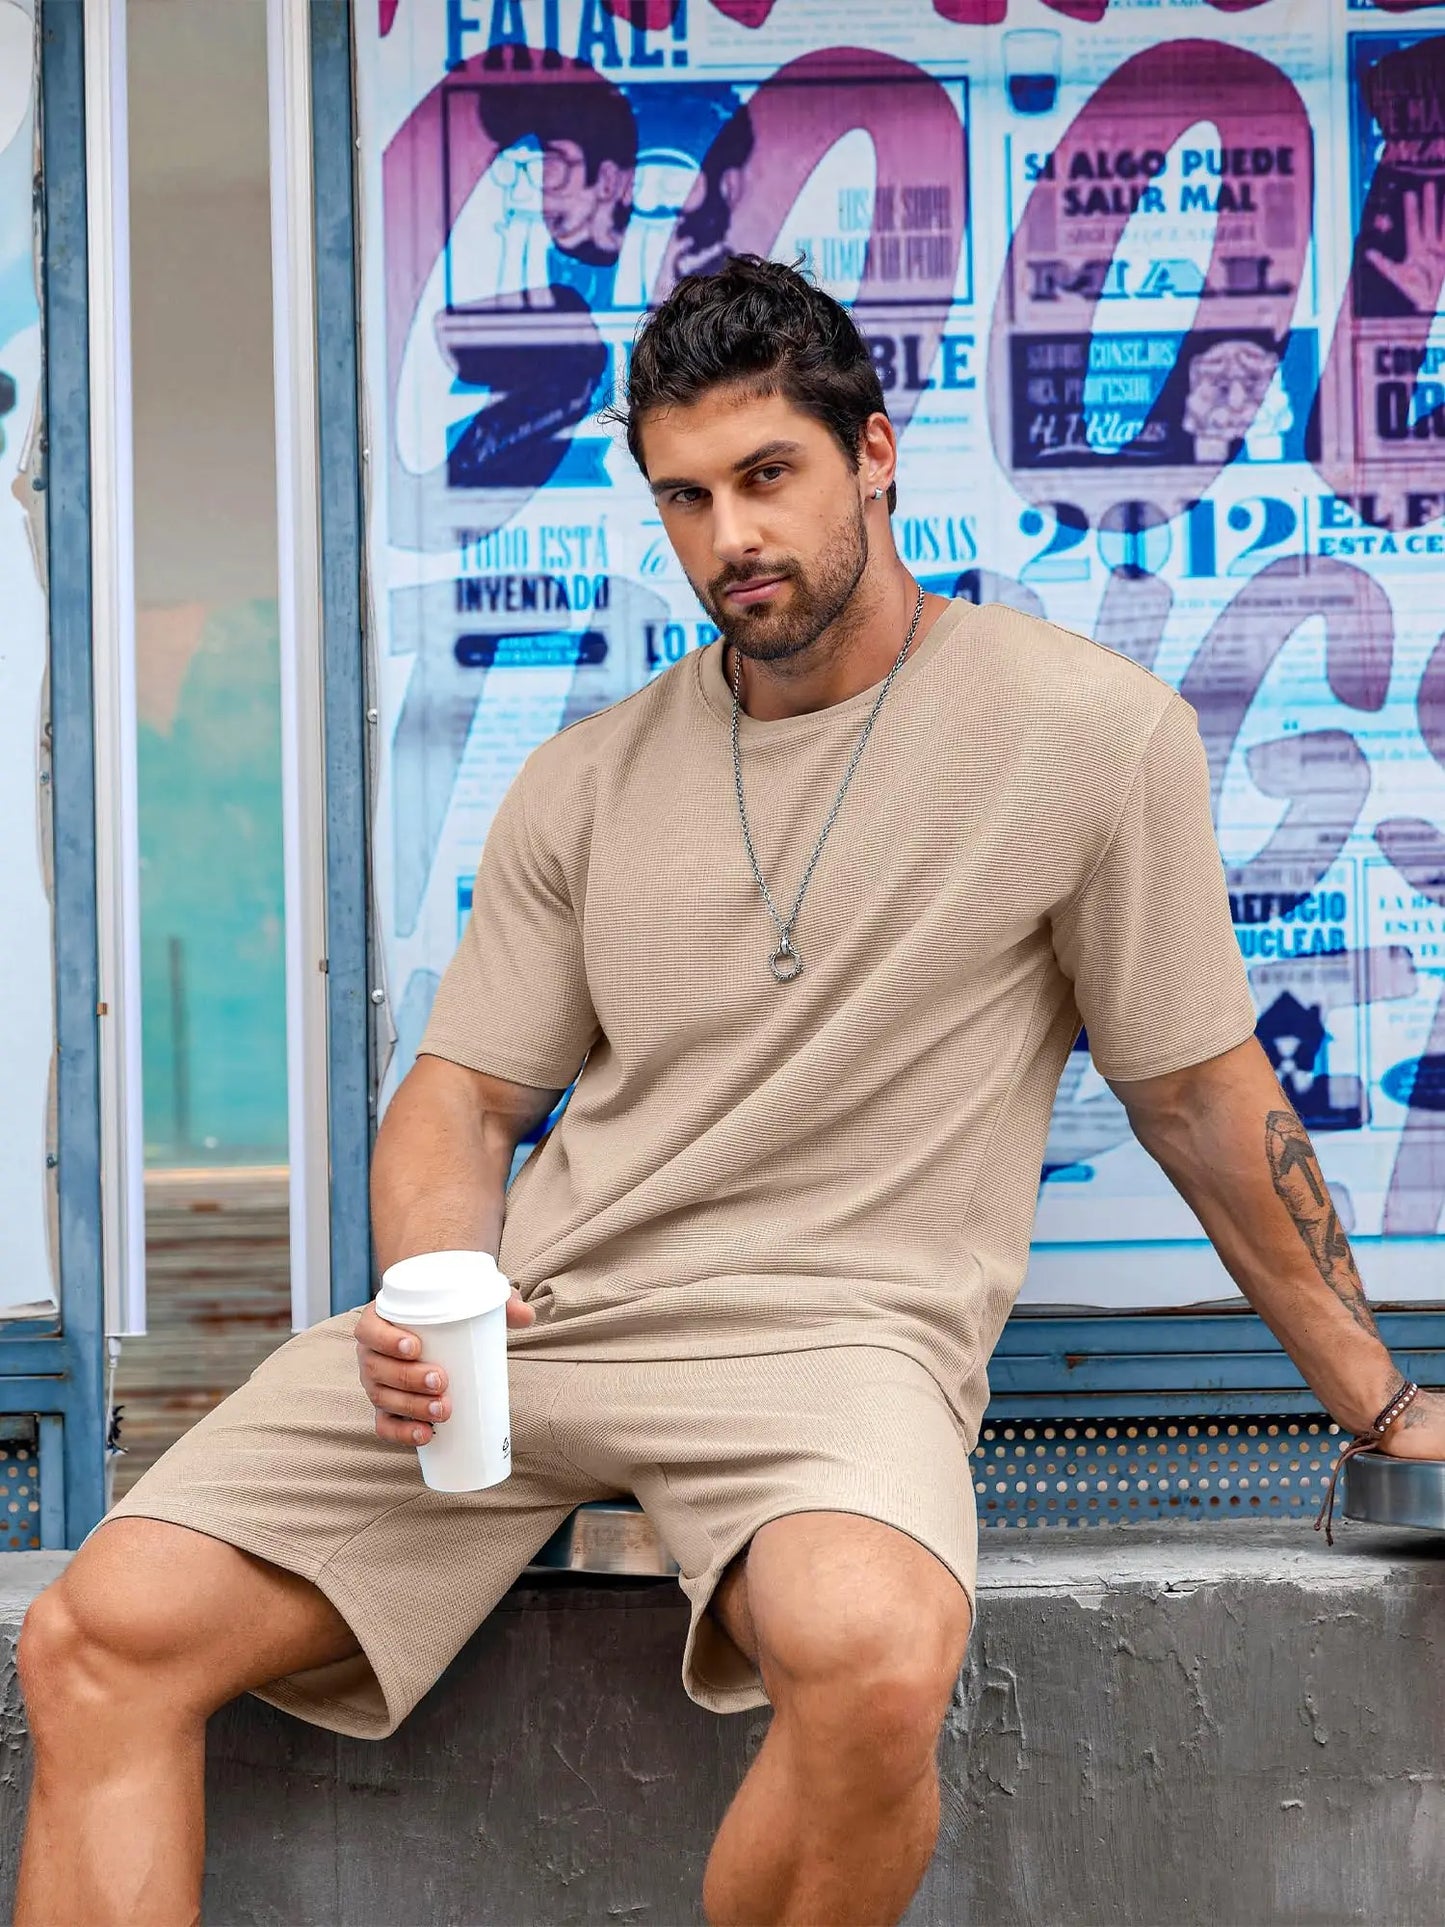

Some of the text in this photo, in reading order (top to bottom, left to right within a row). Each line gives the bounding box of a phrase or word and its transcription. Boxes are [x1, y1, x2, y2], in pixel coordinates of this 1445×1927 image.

[1024, 147, 1295, 181] SI ALGO PUEDE
[1063, 183, 1257, 217] SALIR MAL
[862, 333, 977, 391] BLE
[1318, 491, 1445, 529] EL F
[455, 525, 529, 571] TODO
[539, 514, 609, 570] ESTÁ
[1019, 495, 1298, 584] 2012
[456, 575, 610, 613] INVENTADO
